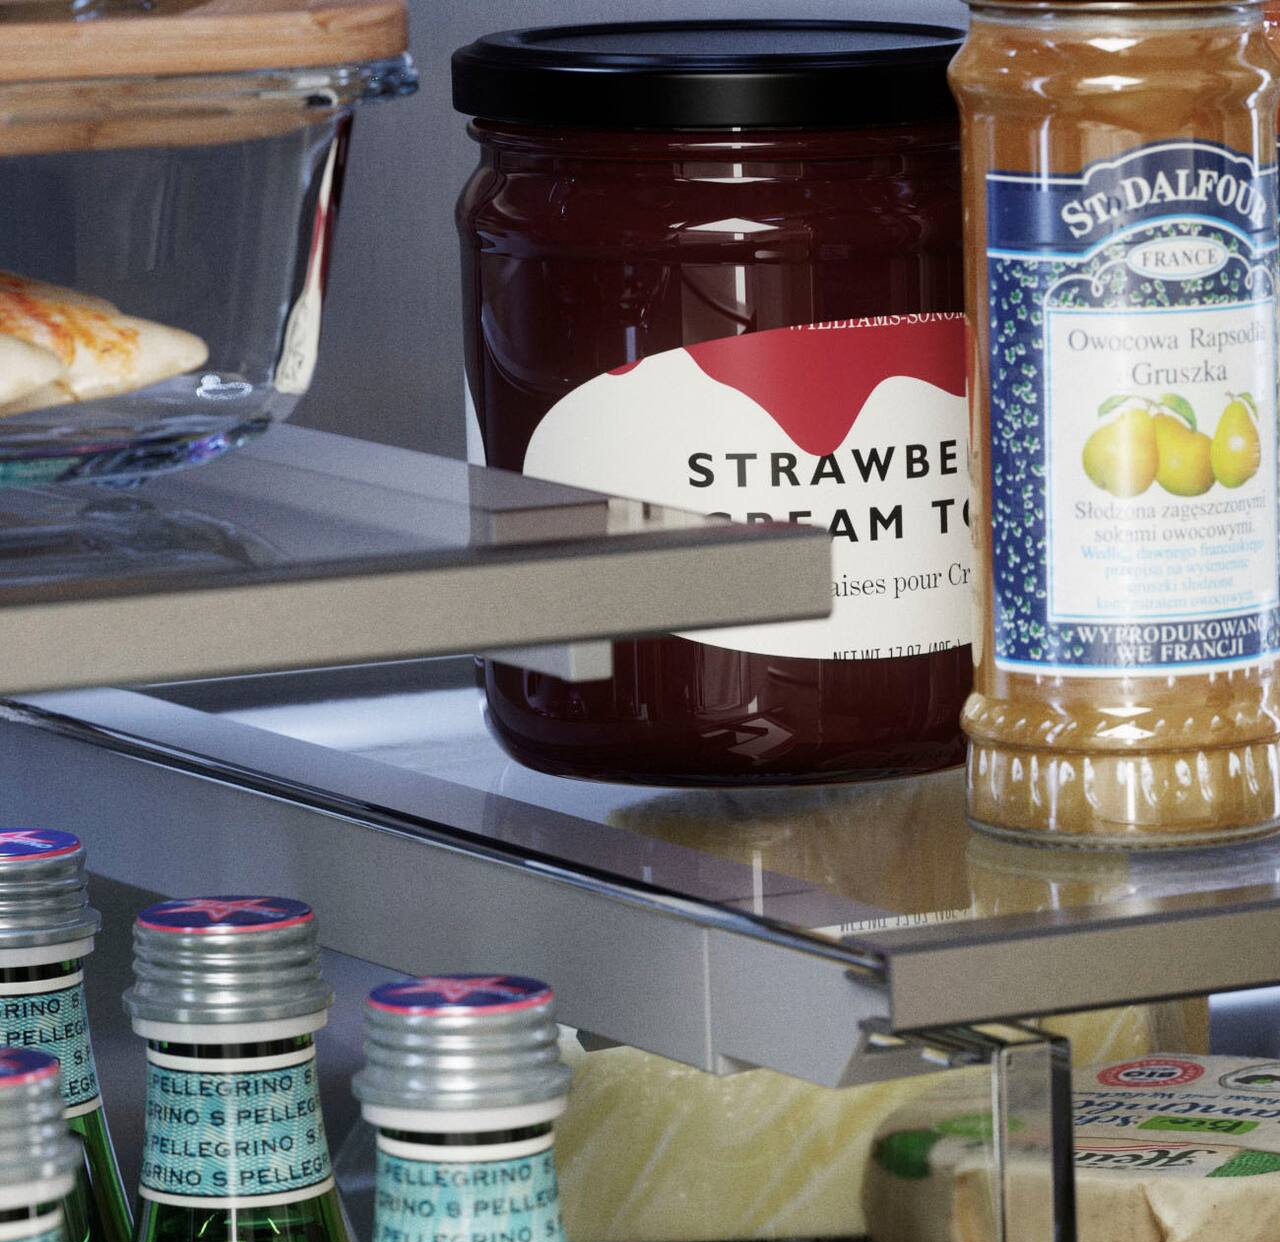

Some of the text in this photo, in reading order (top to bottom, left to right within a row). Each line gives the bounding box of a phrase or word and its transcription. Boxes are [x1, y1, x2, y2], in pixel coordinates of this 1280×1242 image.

[1061, 168, 1267, 239] ST. DALFOUR
[1141, 249, 1218, 268] FRANCE
[1067, 328, 1179, 351] Owocowa
[1131, 360, 1228, 386] Gruszka
[688, 439, 970, 488] STRAWBE
[932, 498, 969, 534] T
[893, 570, 943, 599] pour
[1116, 637, 1244, 663] WE FRANCJI
[0, 998, 60, 1018] RINO
[6, 1020, 88, 1046] PELLEG
[152, 1074, 294, 1098] PELLEGRINO
[150, 1134, 294, 1158] PELLEGRINO
